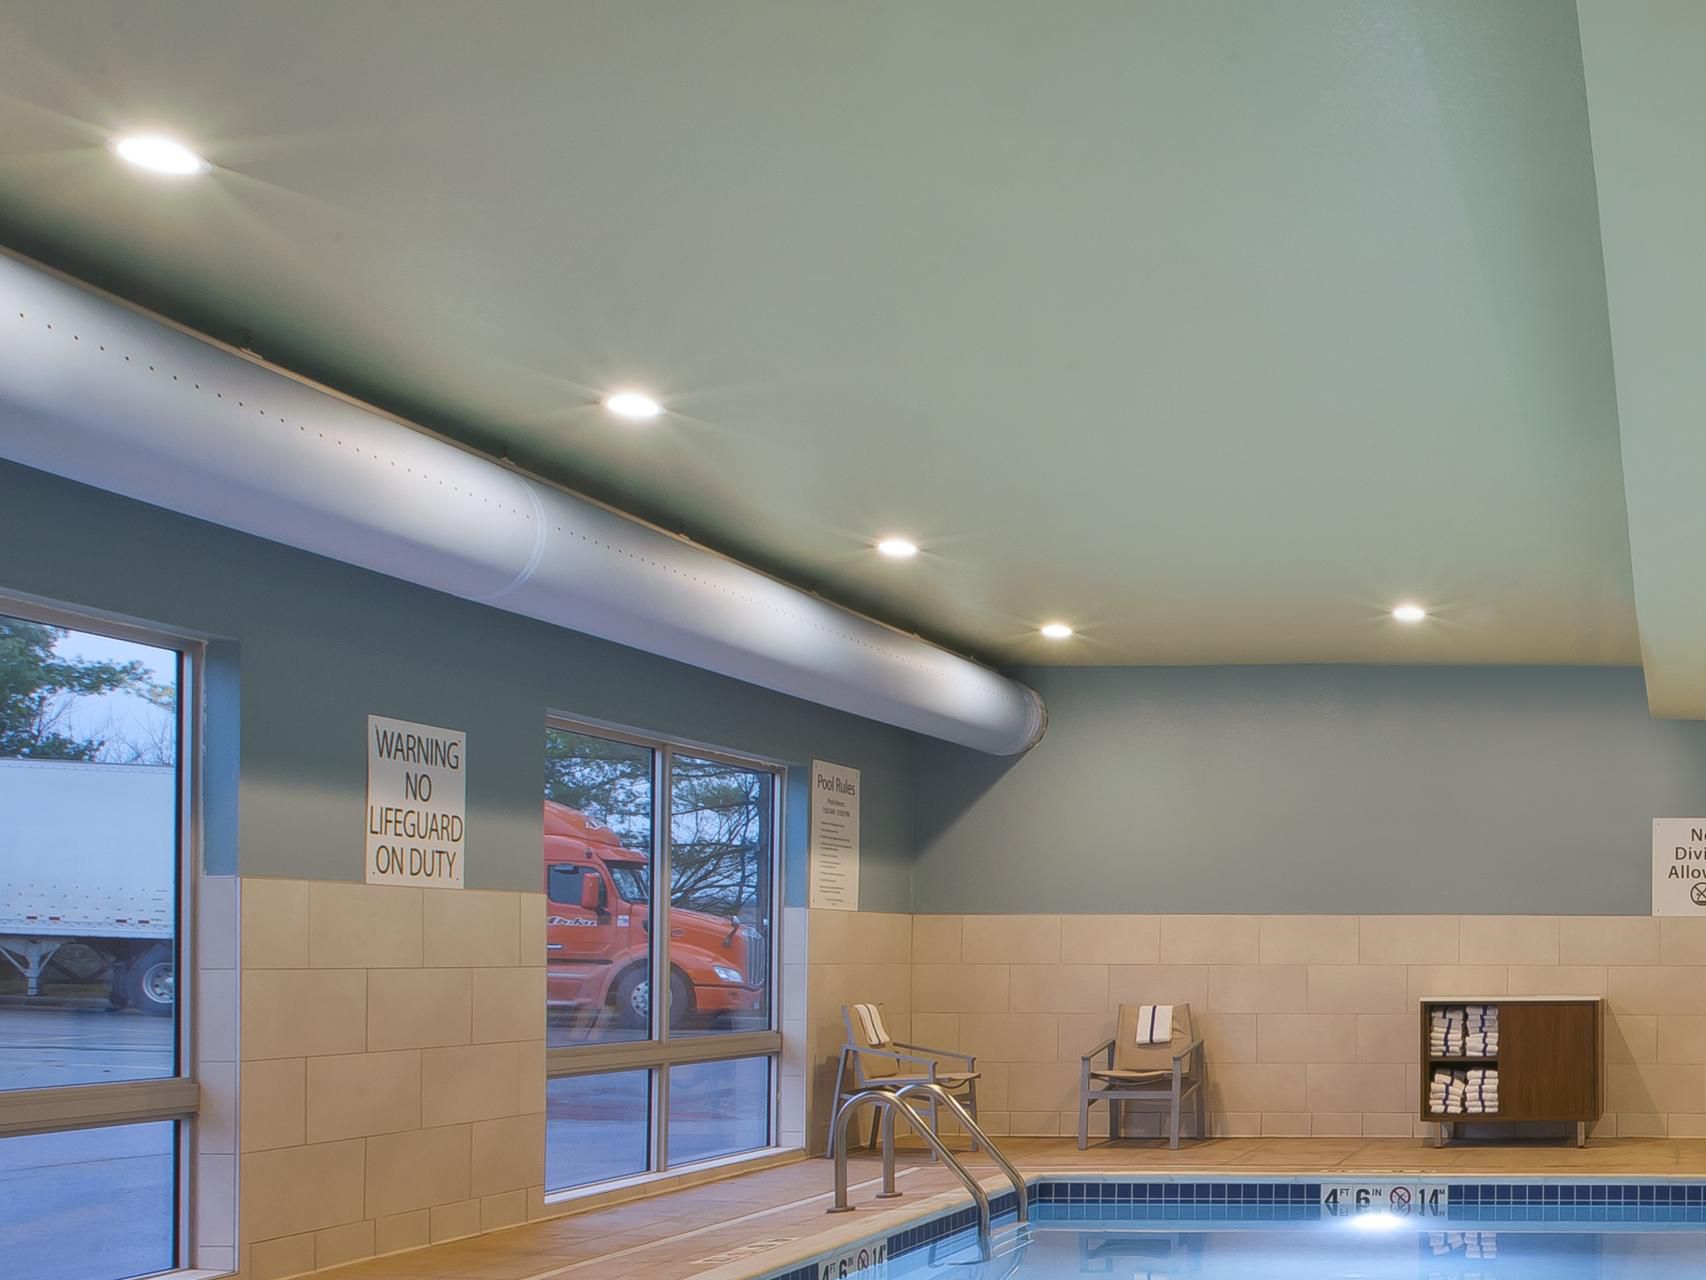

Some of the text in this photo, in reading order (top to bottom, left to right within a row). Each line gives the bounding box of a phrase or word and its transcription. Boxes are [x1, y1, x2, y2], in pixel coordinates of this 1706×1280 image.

[375, 727, 459, 770] WARNING
[405, 772, 432, 802] NO
[817, 774, 856, 796] Pool Rules
[370, 805, 463, 843] LIFEGUARD
[376, 845, 457, 879] ON DUTY
[1324, 1188, 1339, 1204] 4
[1340, 1188, 1350, 1196] FT
[1355, 1188, 1371, 1204] 6
[1372, 1188, 1382, 1196] IN
[830, 1262, 836, 1274] FT
[839, 1259, 848, 1280] 6
